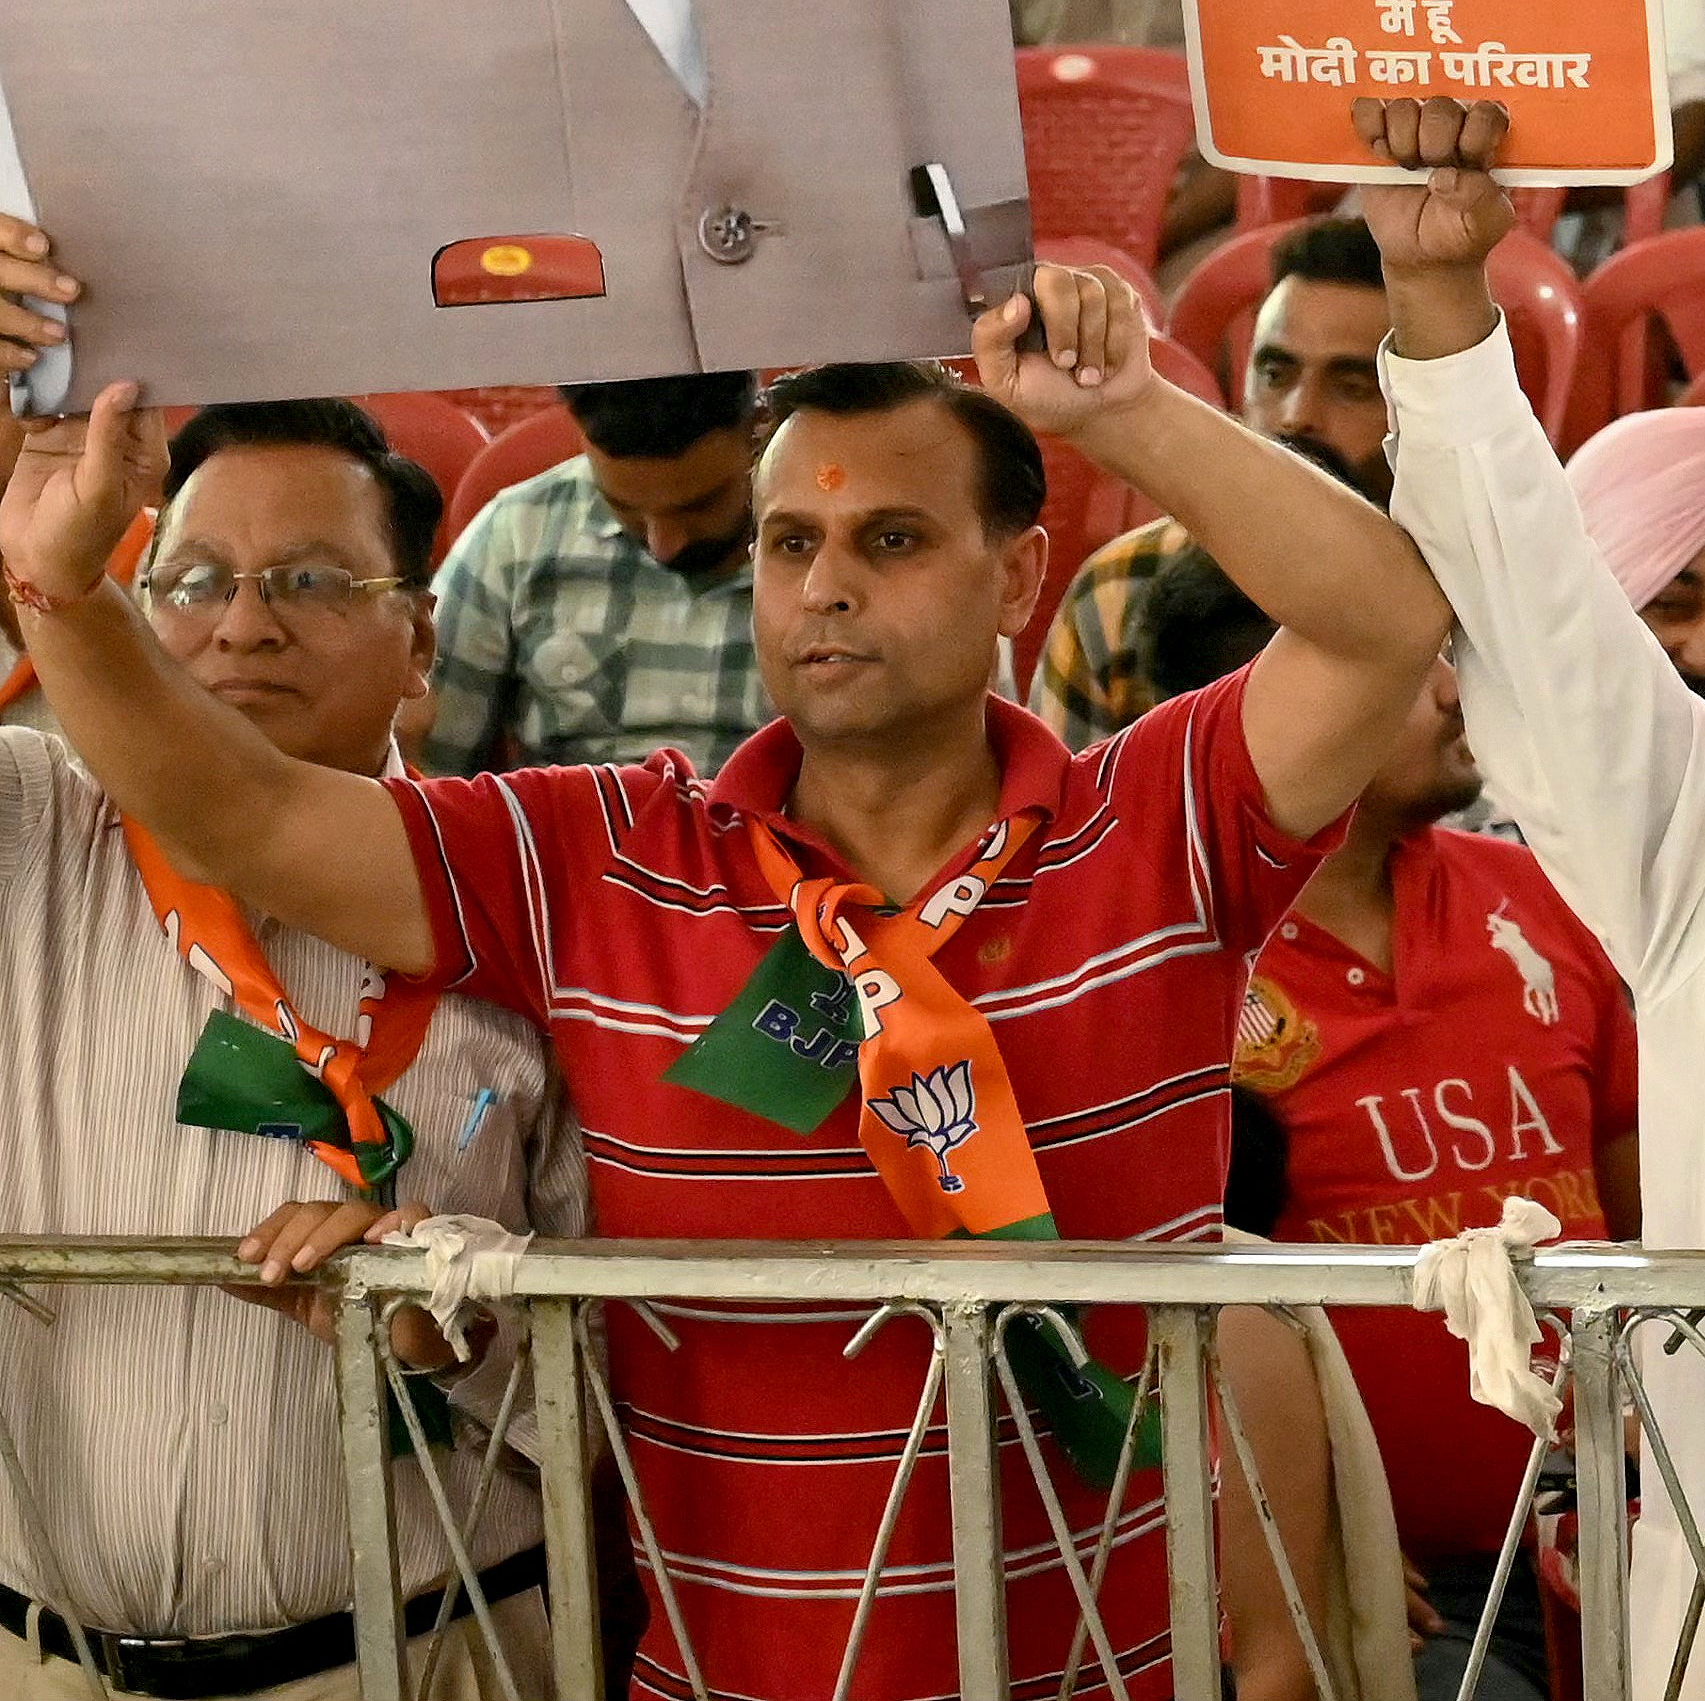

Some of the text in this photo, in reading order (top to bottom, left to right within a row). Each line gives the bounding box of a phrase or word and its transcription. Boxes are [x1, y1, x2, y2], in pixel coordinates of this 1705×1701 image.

[1256, 34, 1592, 89] मोदी का परिवार
[1355, 1065, 1566, 1182] USA
